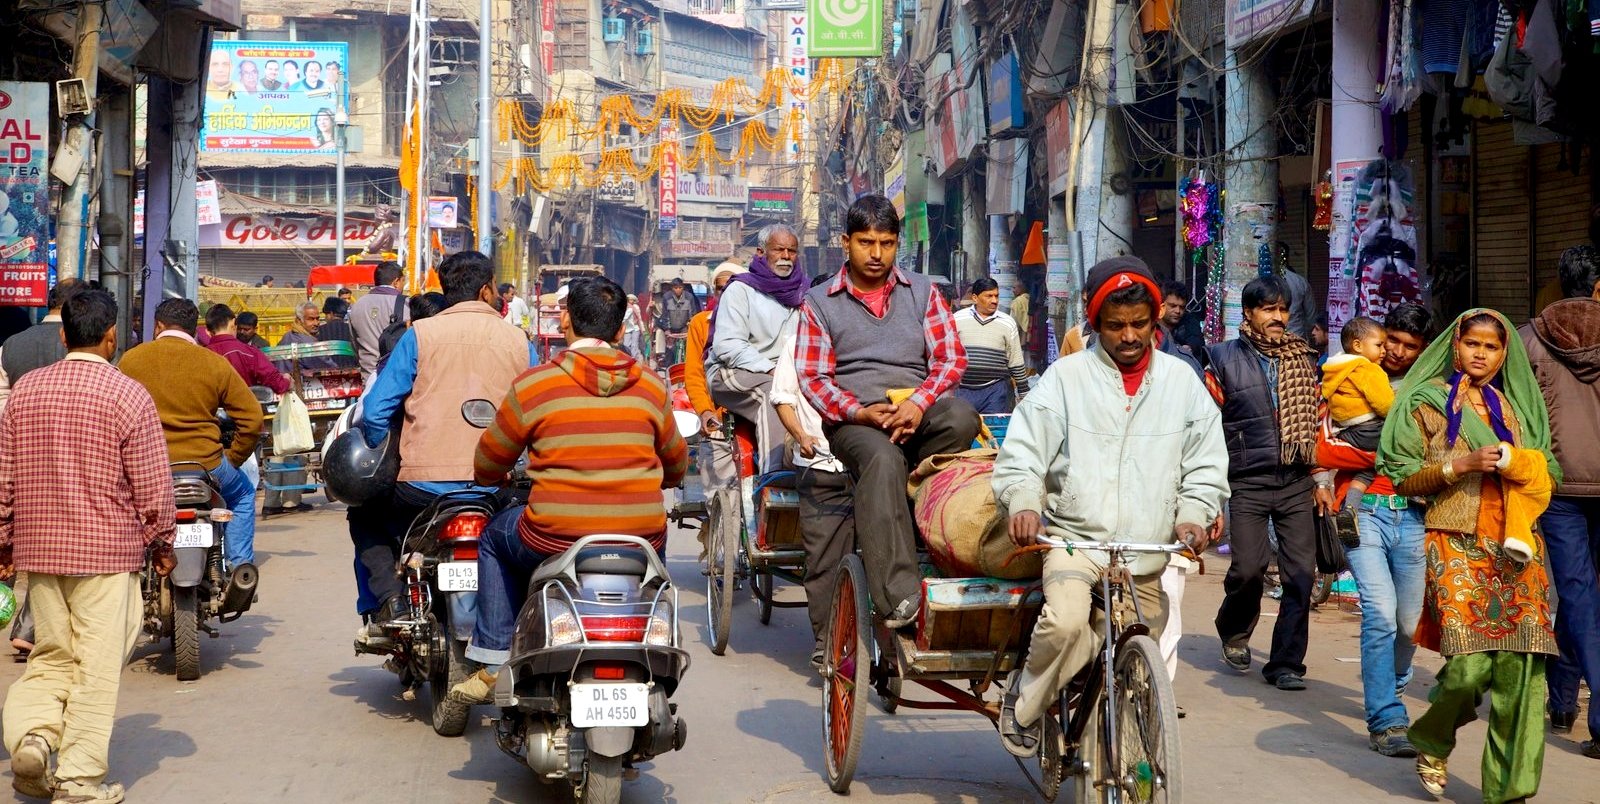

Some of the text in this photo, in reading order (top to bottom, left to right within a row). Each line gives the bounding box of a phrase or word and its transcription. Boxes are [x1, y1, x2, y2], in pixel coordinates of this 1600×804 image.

[209, 104, 312, 132] हार्दिक अभिनन्दन
[9, 167, 40, 176] TEA
[720, 179, 745, 198] House
[225, 216, 298, 245] Gole
[4, 272, 46, 280] FRUITS
[191, 525, 202, 533] 6S
[449, 580, 454, 588] F
[593, 688, 627, 700] DL 6S
[586, 706, 637, 720] AH 4550
